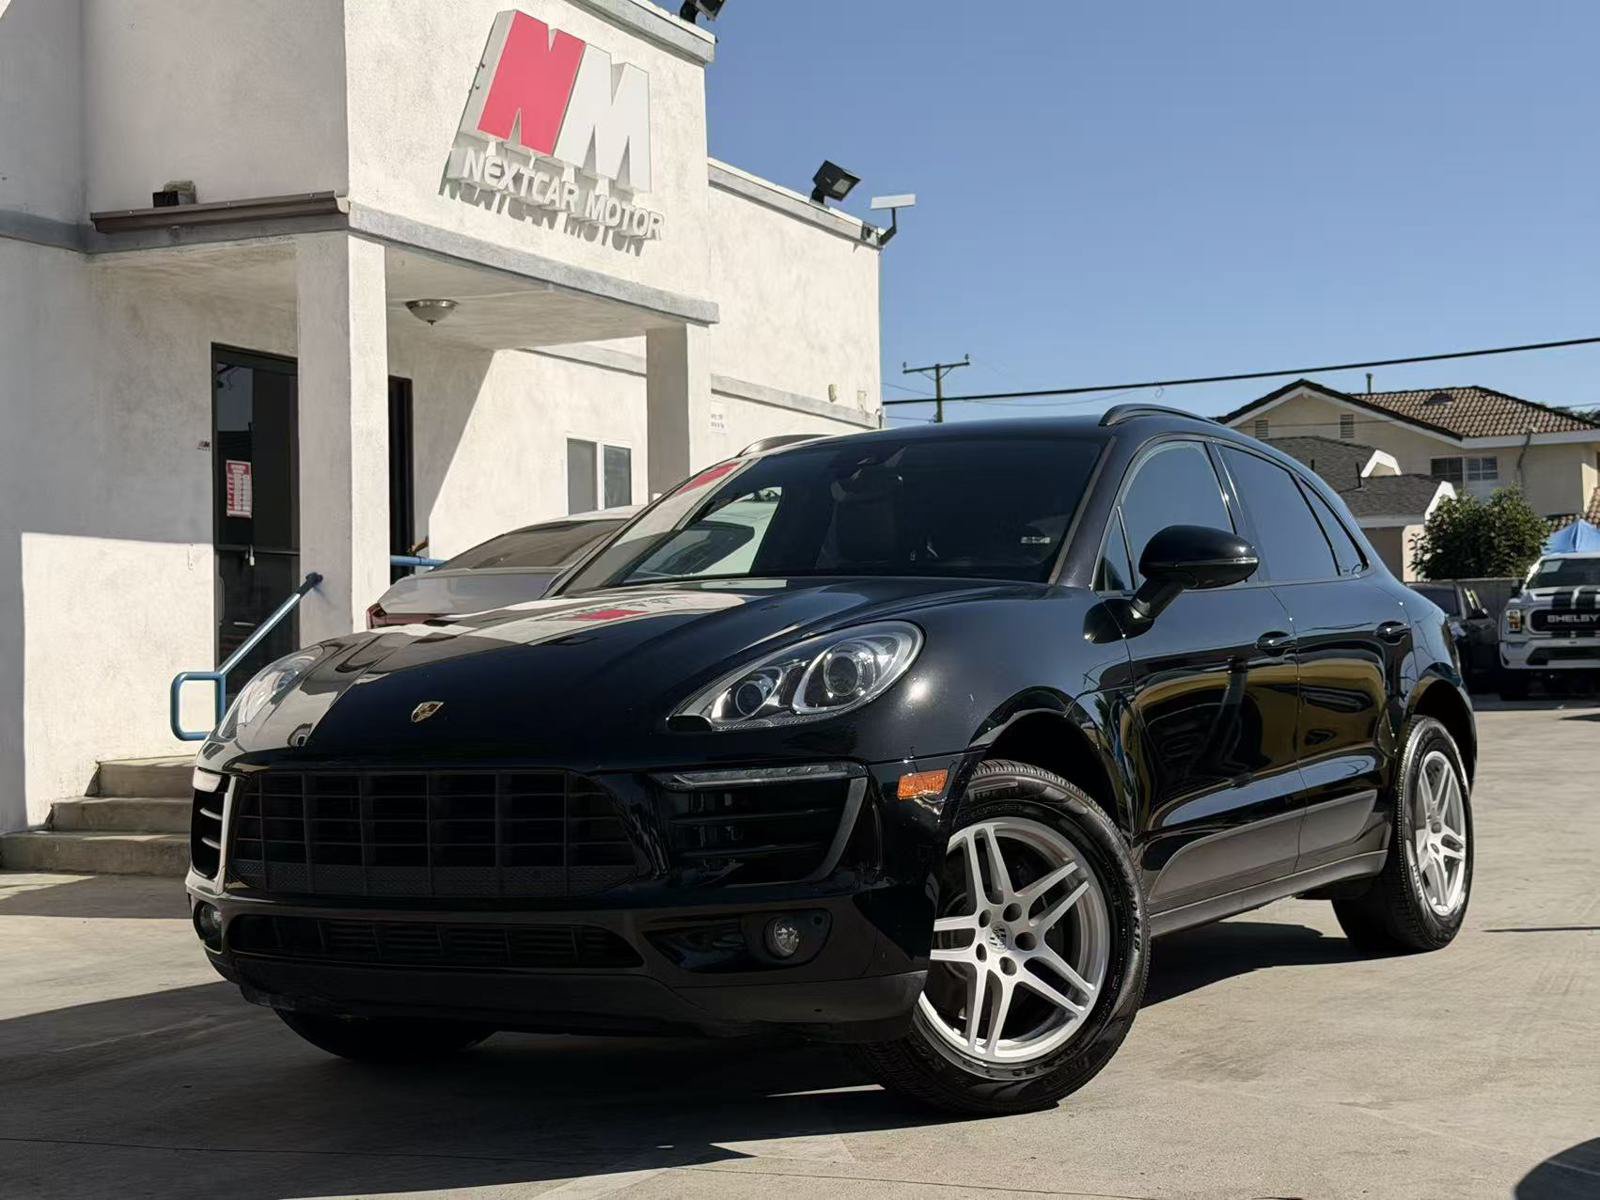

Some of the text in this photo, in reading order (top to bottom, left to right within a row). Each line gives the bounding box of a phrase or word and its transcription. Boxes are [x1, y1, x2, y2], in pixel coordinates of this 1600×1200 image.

[476, 9, 652, 194] NM
[462, 149, 665, 241] NEXTCAR MOTOR
[1547, 614, 1600, 623] SHELBY
